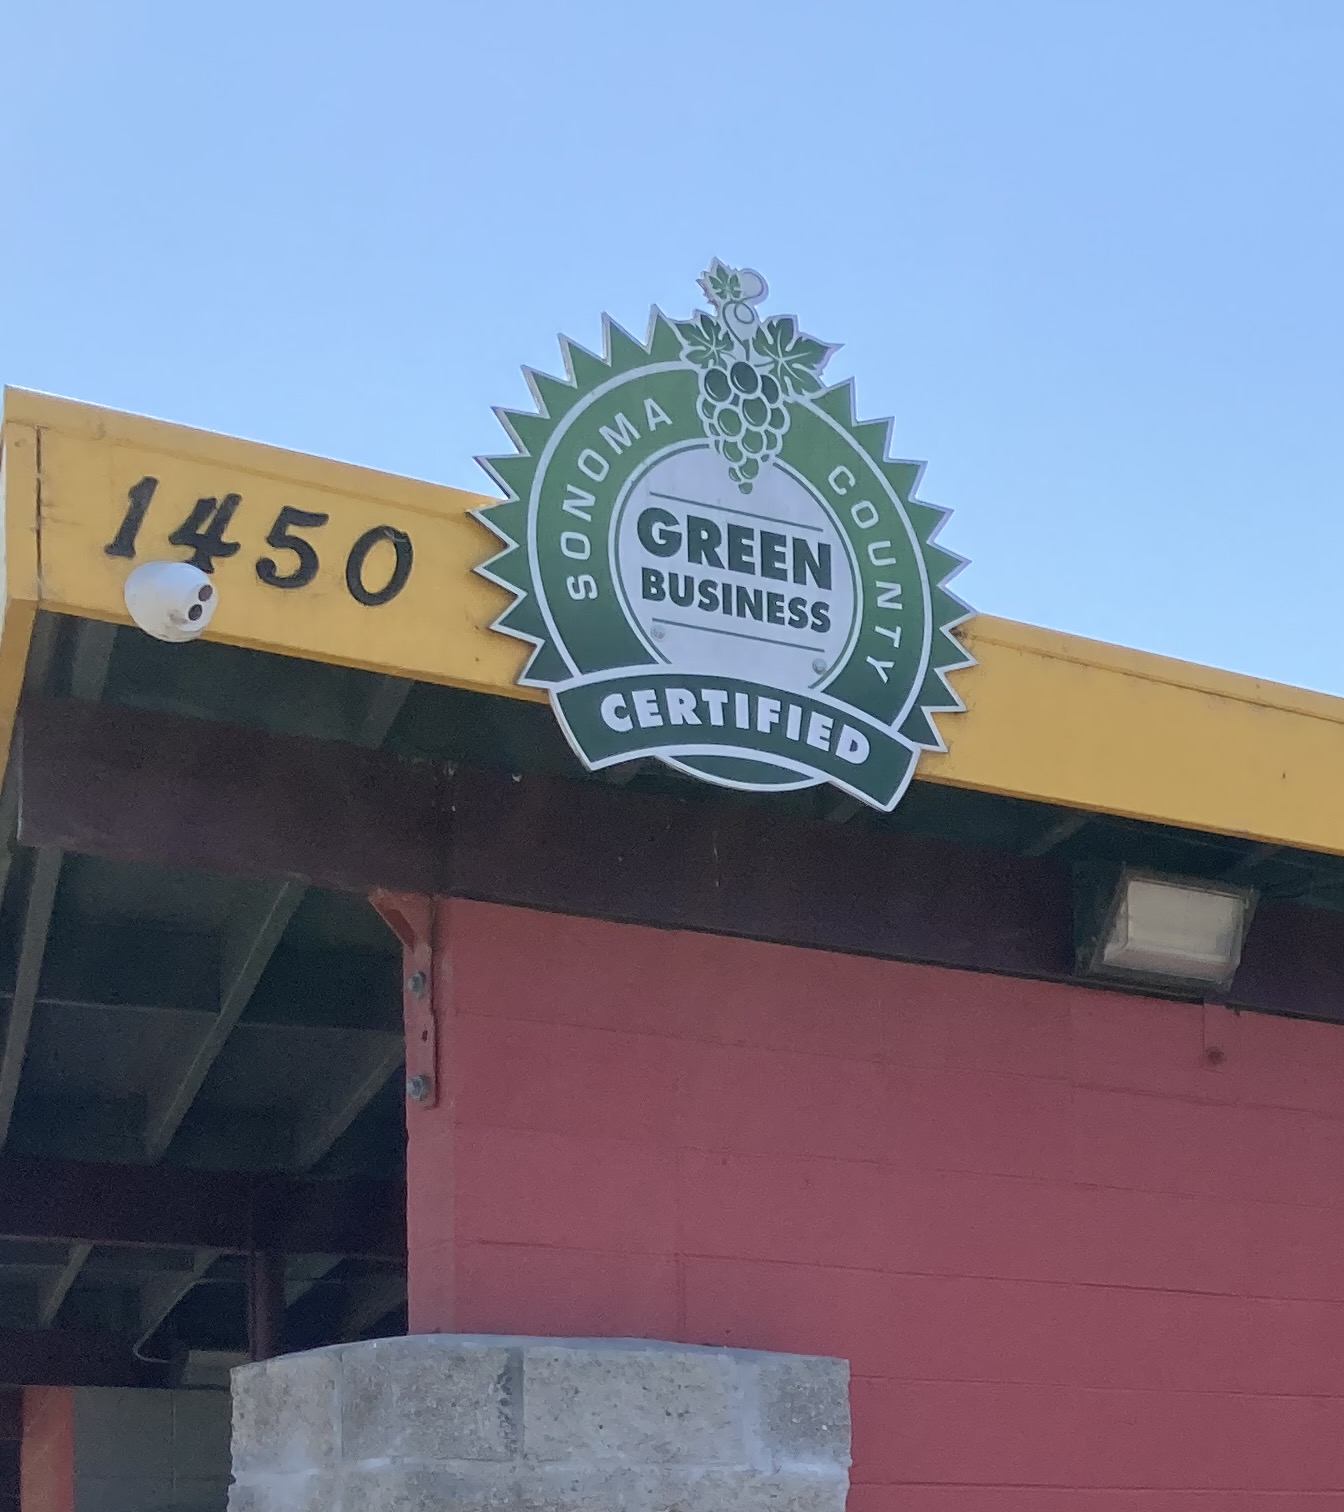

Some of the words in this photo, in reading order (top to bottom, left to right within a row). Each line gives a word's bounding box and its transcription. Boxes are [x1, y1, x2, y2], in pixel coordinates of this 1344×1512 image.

[103, 474, 414, 607] 1450
[565, 396, 674, 601] SONOMA
[636, 506, 833, 590] GREEN
[640, 566, 833, 633] BUSINESS
[829, 463, 905, 683] COUNTY
[600, 686, 871, 766] CERTIFIED
